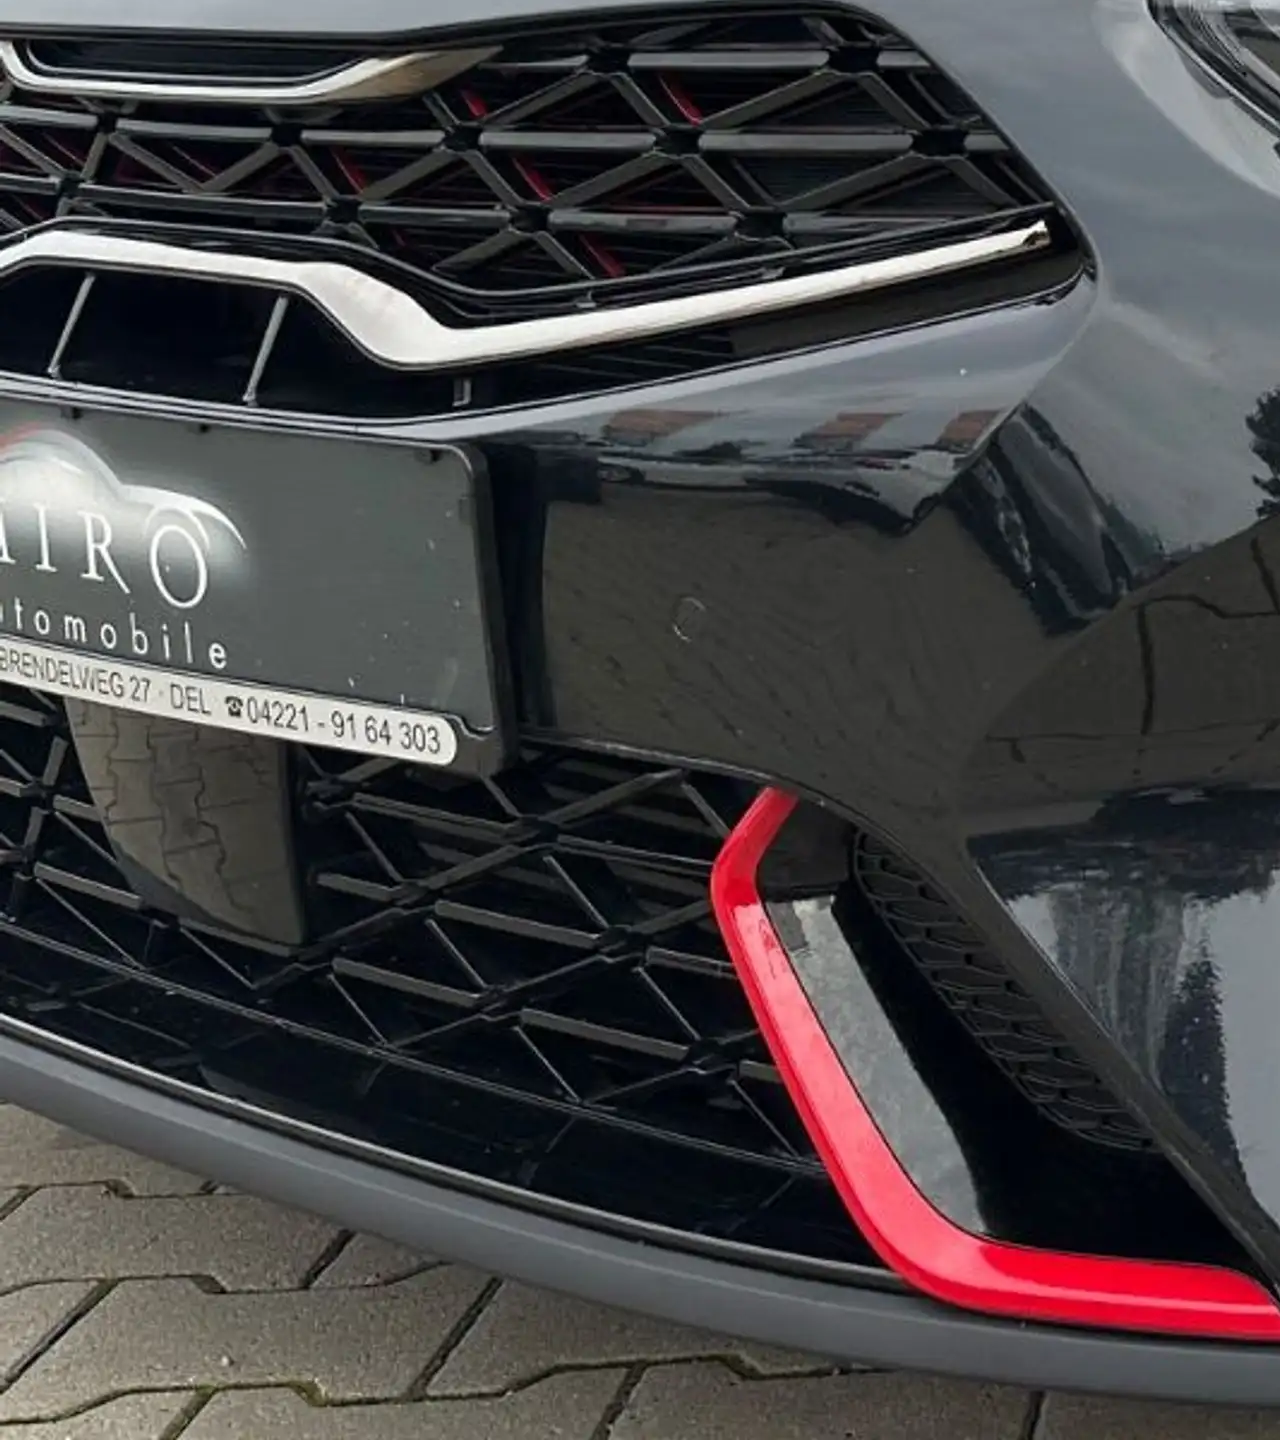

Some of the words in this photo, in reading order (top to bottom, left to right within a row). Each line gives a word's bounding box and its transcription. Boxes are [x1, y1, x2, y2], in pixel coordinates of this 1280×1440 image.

[0, 499, 208, 608] IRO
[0, 597, 227, 670] tomobile
[129, 676, 151, 701] 27
[170, 684, 211, 716] DEL
[247, 696, 312, 733] 04221
[331, 710, 358, 741] 91
[364, 717, 391, 746] 64
[400, 722, 441, 755] 303
